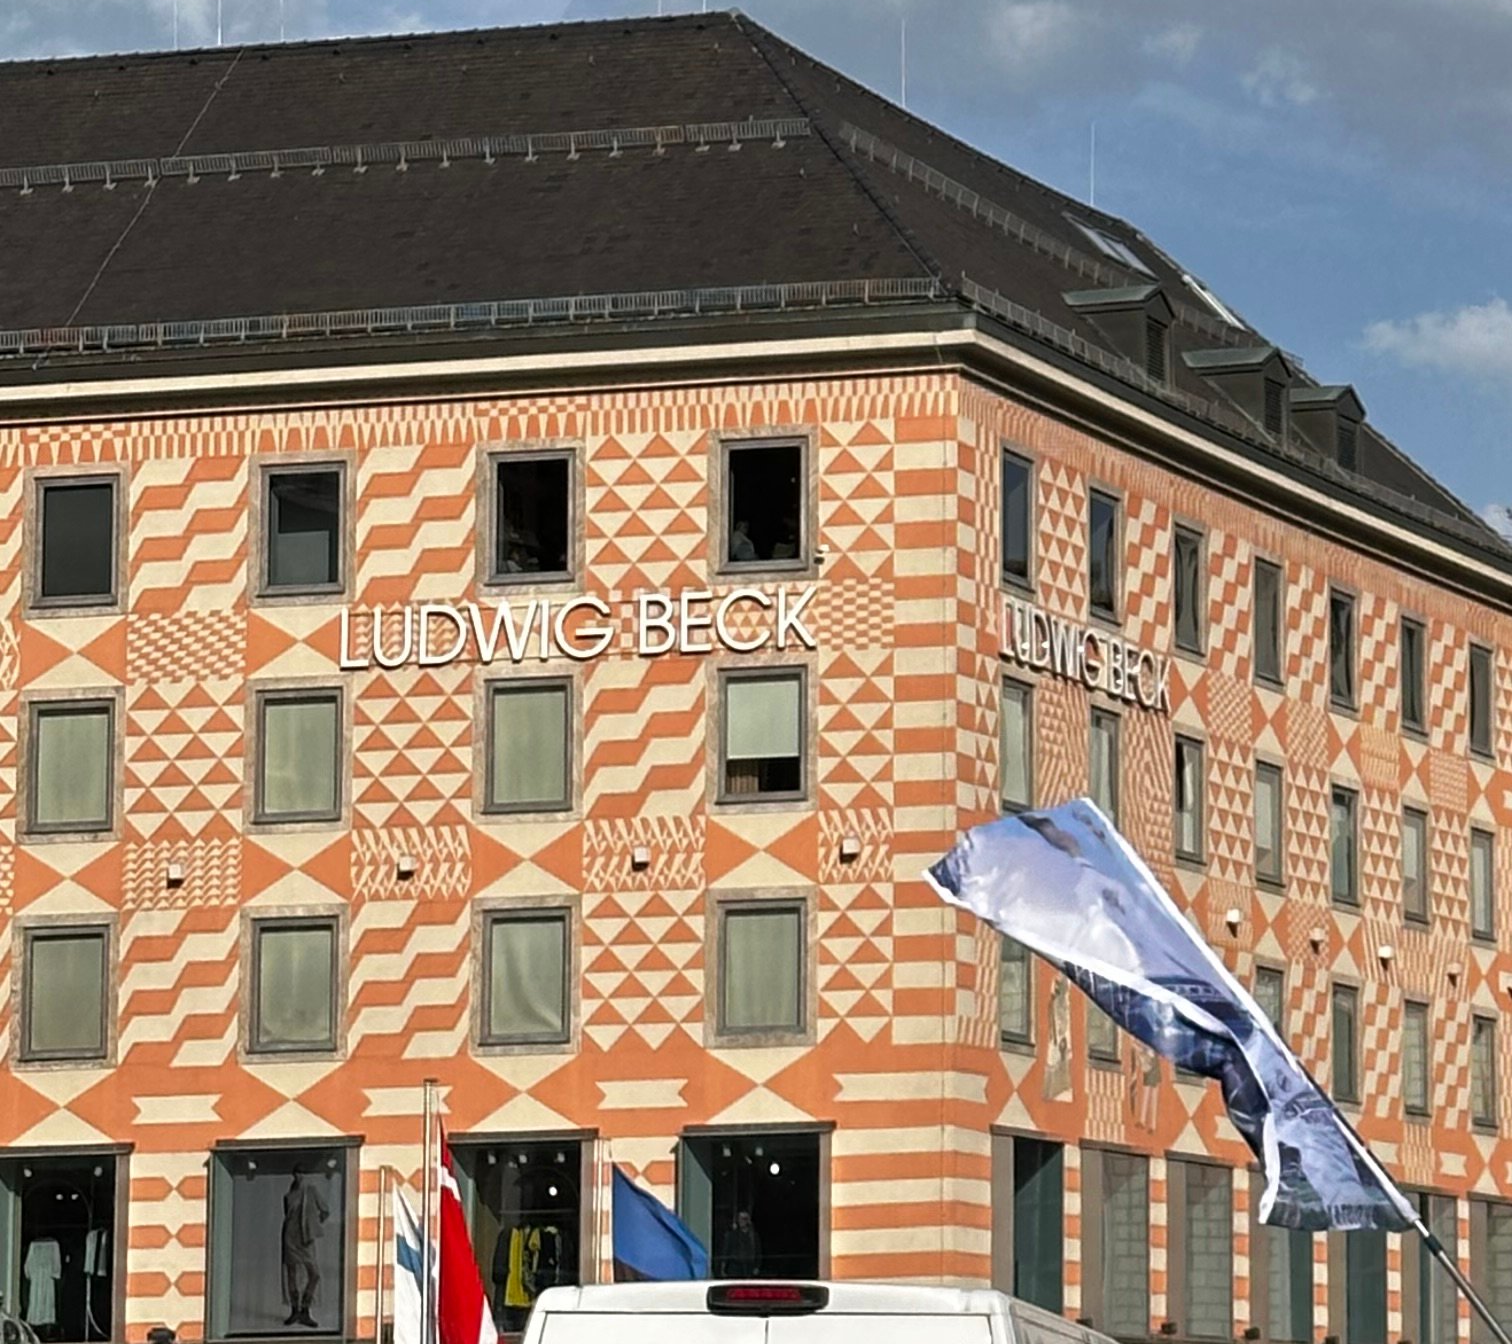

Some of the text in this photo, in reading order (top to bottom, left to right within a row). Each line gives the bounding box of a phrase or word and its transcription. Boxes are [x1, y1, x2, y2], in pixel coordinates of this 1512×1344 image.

[340, 587, 817, 670] LUDWIG BECK
[1002, 596, 1172, 712] LUDWIG BECK
